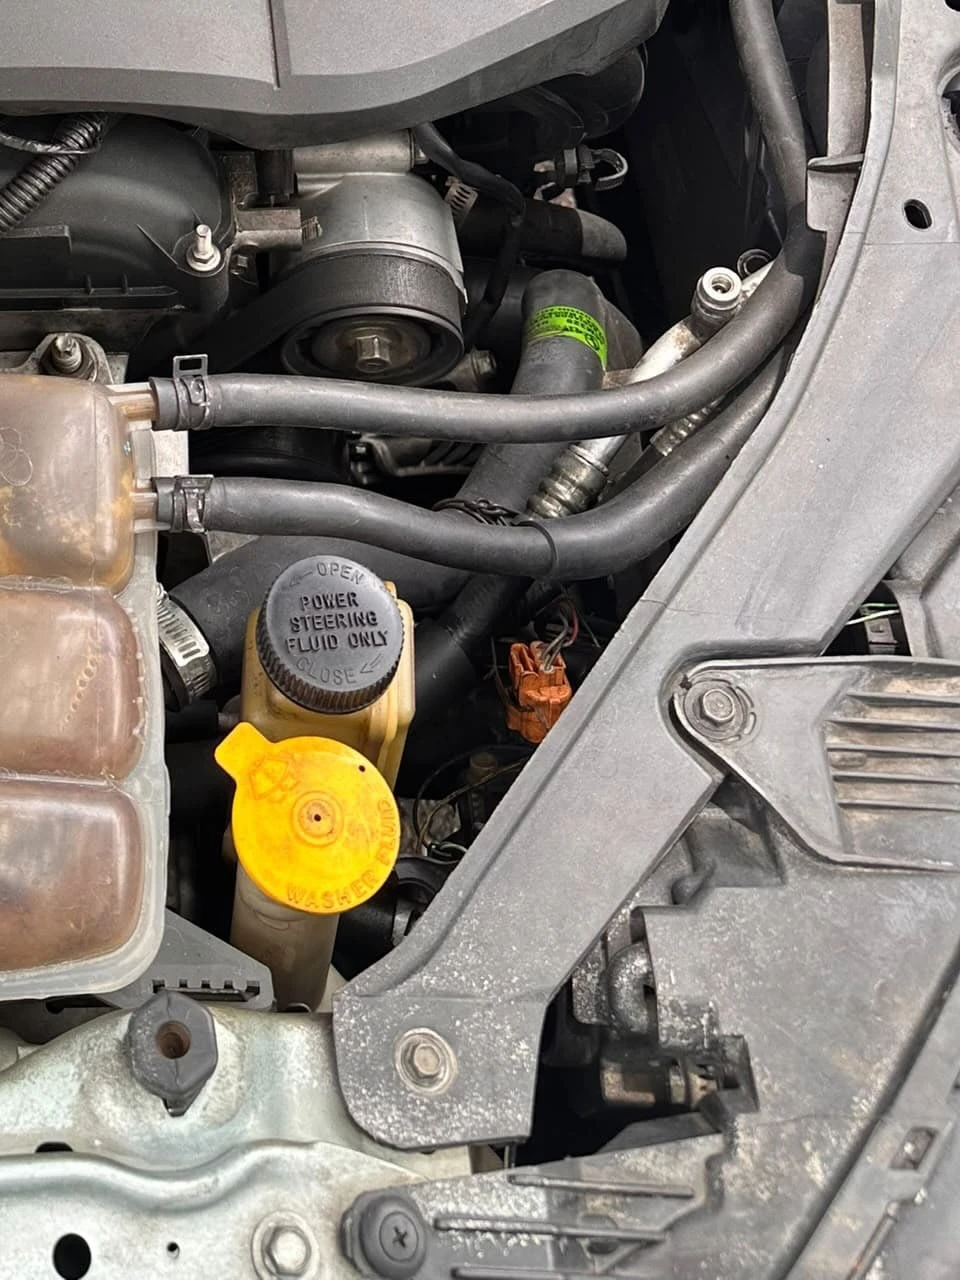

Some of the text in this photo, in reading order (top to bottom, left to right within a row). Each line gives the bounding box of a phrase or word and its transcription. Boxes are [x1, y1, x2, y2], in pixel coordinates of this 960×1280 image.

[316, 562, 365, 585] OPEN
[300, 592, 360, 611] POWER
[289, 611, 378, 633] STEERING
[285, 630, 389, 654] FLUID ONLY
[296, 656, 357, 686] CLOSE
[287, 798, 396, 909] WASHER FLUID
